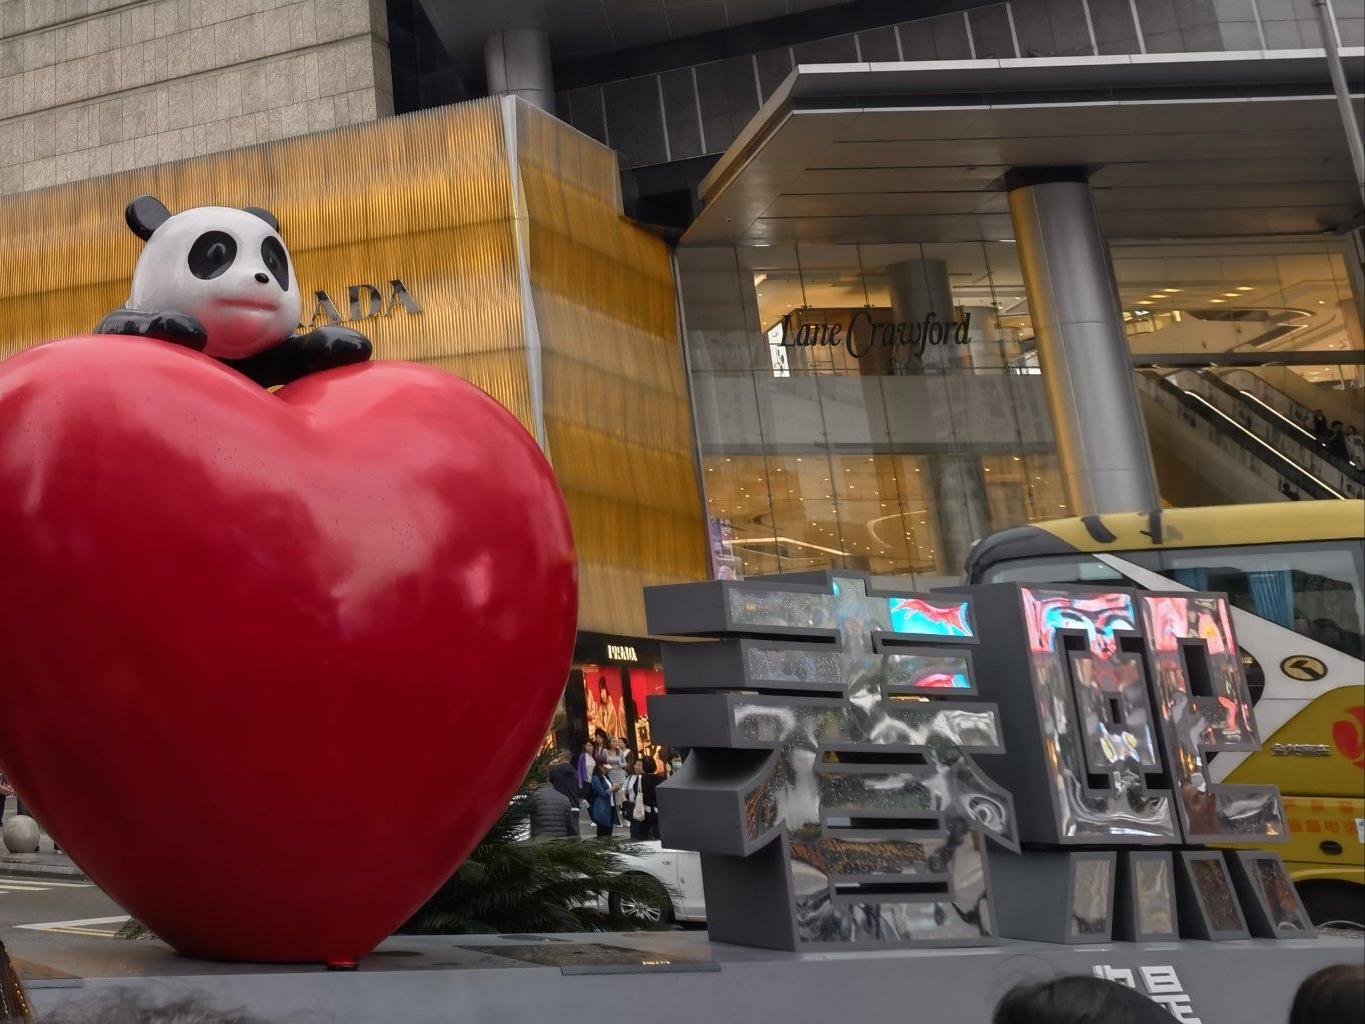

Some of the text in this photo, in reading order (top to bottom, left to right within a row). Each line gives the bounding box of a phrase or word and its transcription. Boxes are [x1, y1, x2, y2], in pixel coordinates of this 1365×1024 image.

[298, 279, 423, 328] ADA
[776, 311, 972, 358] Lane Crawford
